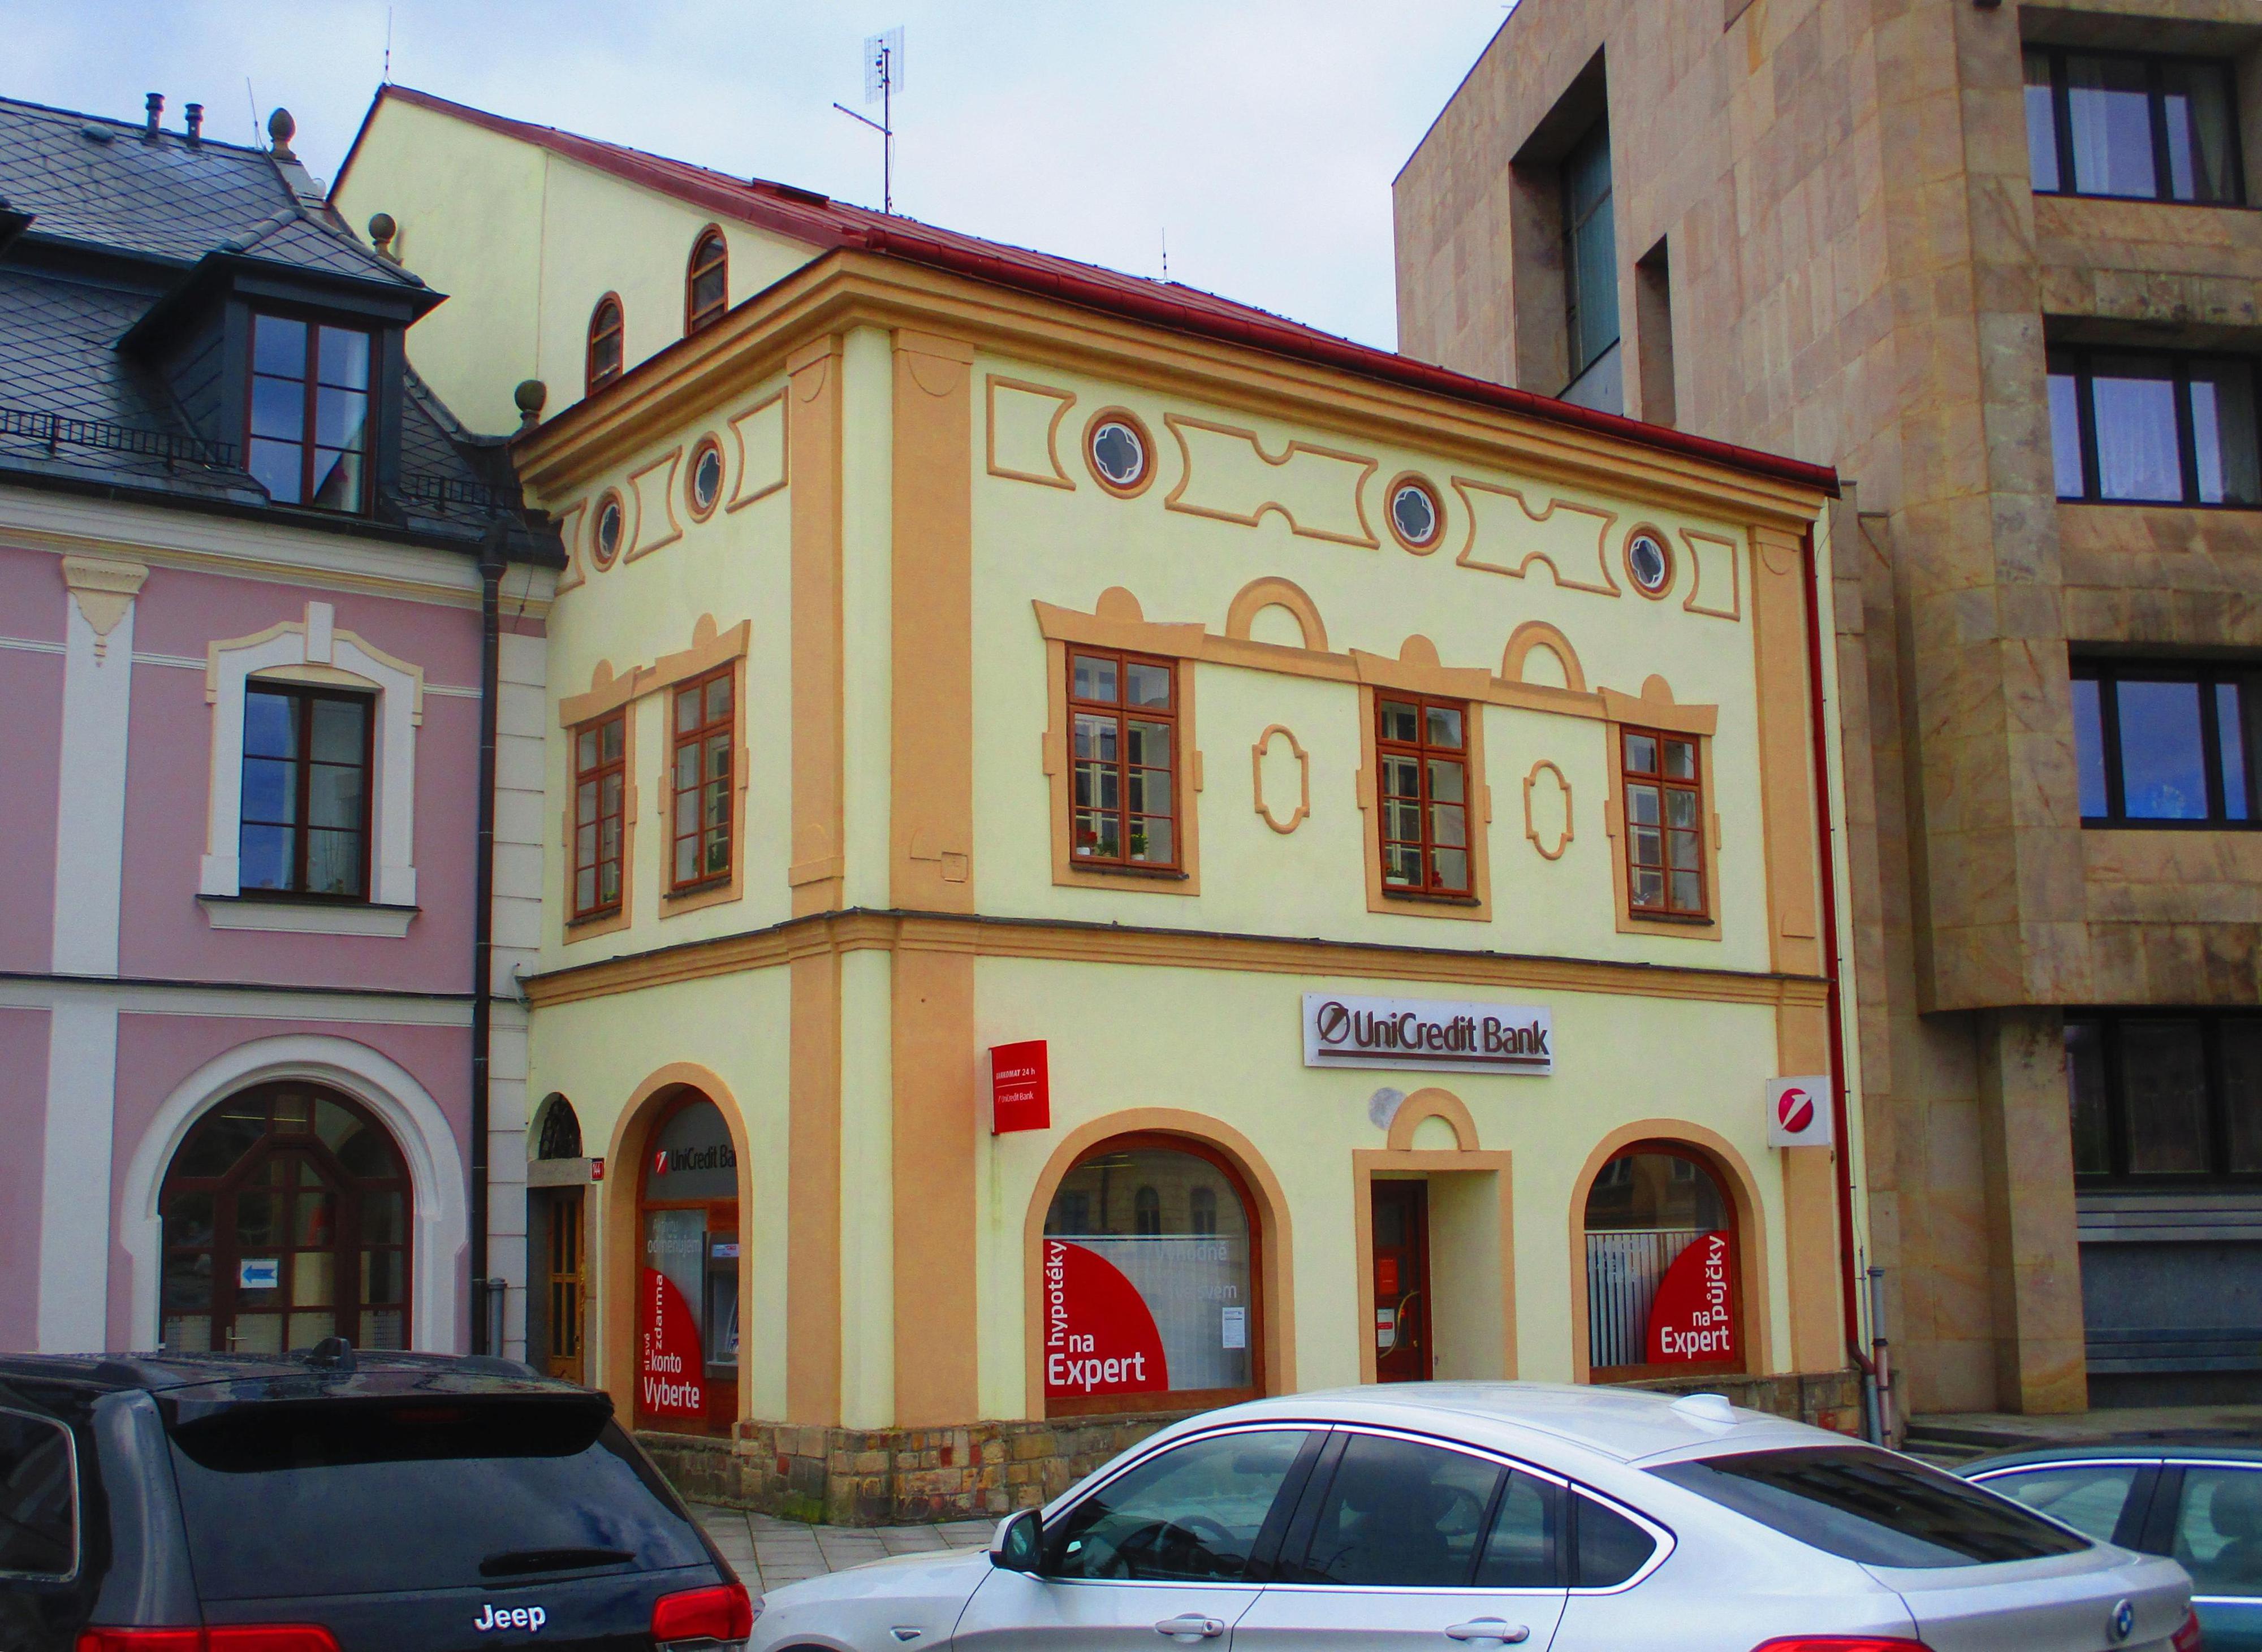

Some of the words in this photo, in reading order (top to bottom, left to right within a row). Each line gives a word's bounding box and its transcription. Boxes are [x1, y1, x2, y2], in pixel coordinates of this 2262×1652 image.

[1354, 1010, 1477, 1053] UniCredit
[1483, 1017, 1549, 1056] Bank
[1020, 1091, 1034, 1101] Bank
[671, 1145, 717, 1171] UniCredit
[1706, 1235, 1728, 1321] půjčky
[1046, 1241, 1068, 1346] hypotéky
[1693, 1309, 1710, 1326] na
[1069, 1334, 1094, 1352] na
[1661, 1326, 1730, 1359] Expert
[651, 1349, 681, 1373] konto
[1048, 1352, 1146, 1392] Expert
[644, 1376, 700, 1411] Vyberte
[474, 1605, 546, 1632] Jeep
